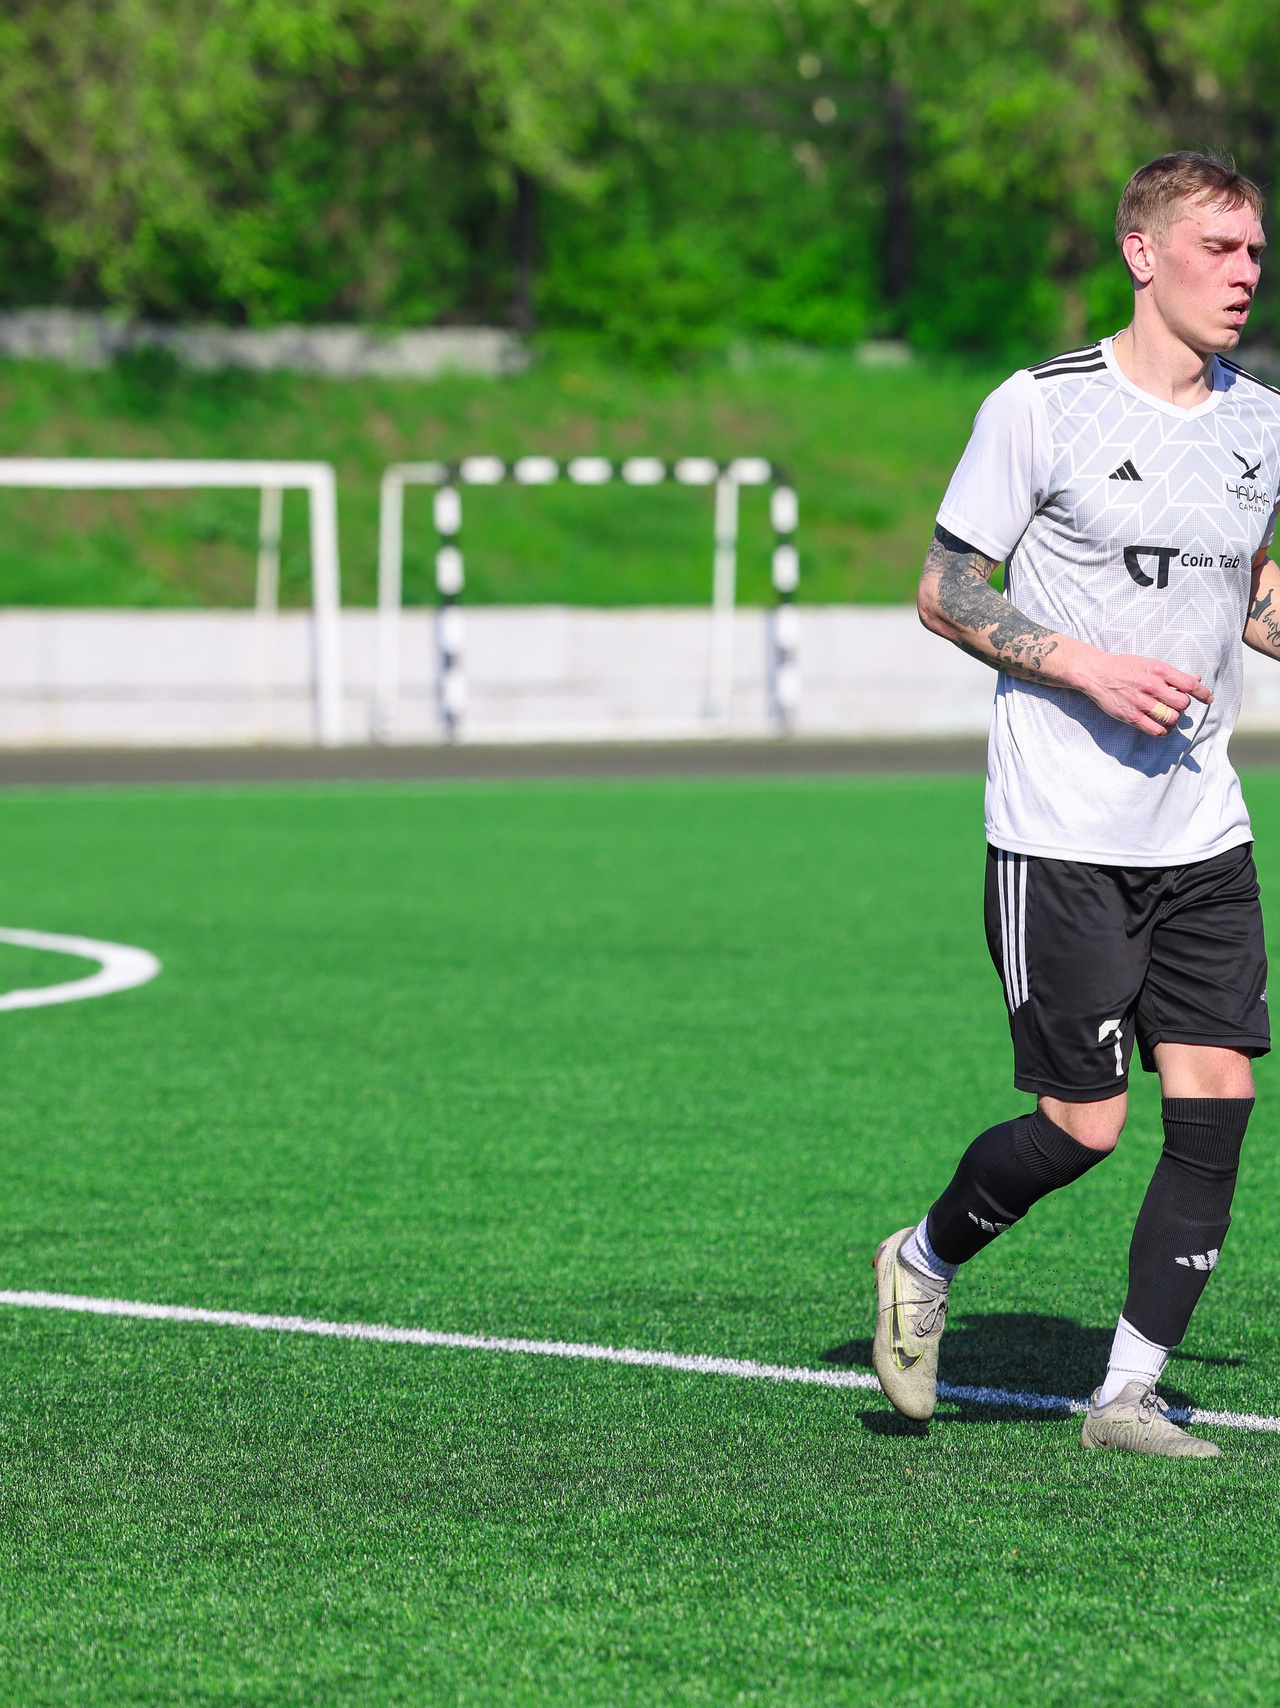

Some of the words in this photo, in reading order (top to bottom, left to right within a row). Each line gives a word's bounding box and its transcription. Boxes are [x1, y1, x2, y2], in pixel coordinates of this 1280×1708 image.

[1226, 483, 1271, 508] ЧАЙКА
[1238, 502, 1266, 515] САМАРА
[1181, 553, 1214, 568] Coin
[1219, 554, 1240, 569] Tab
